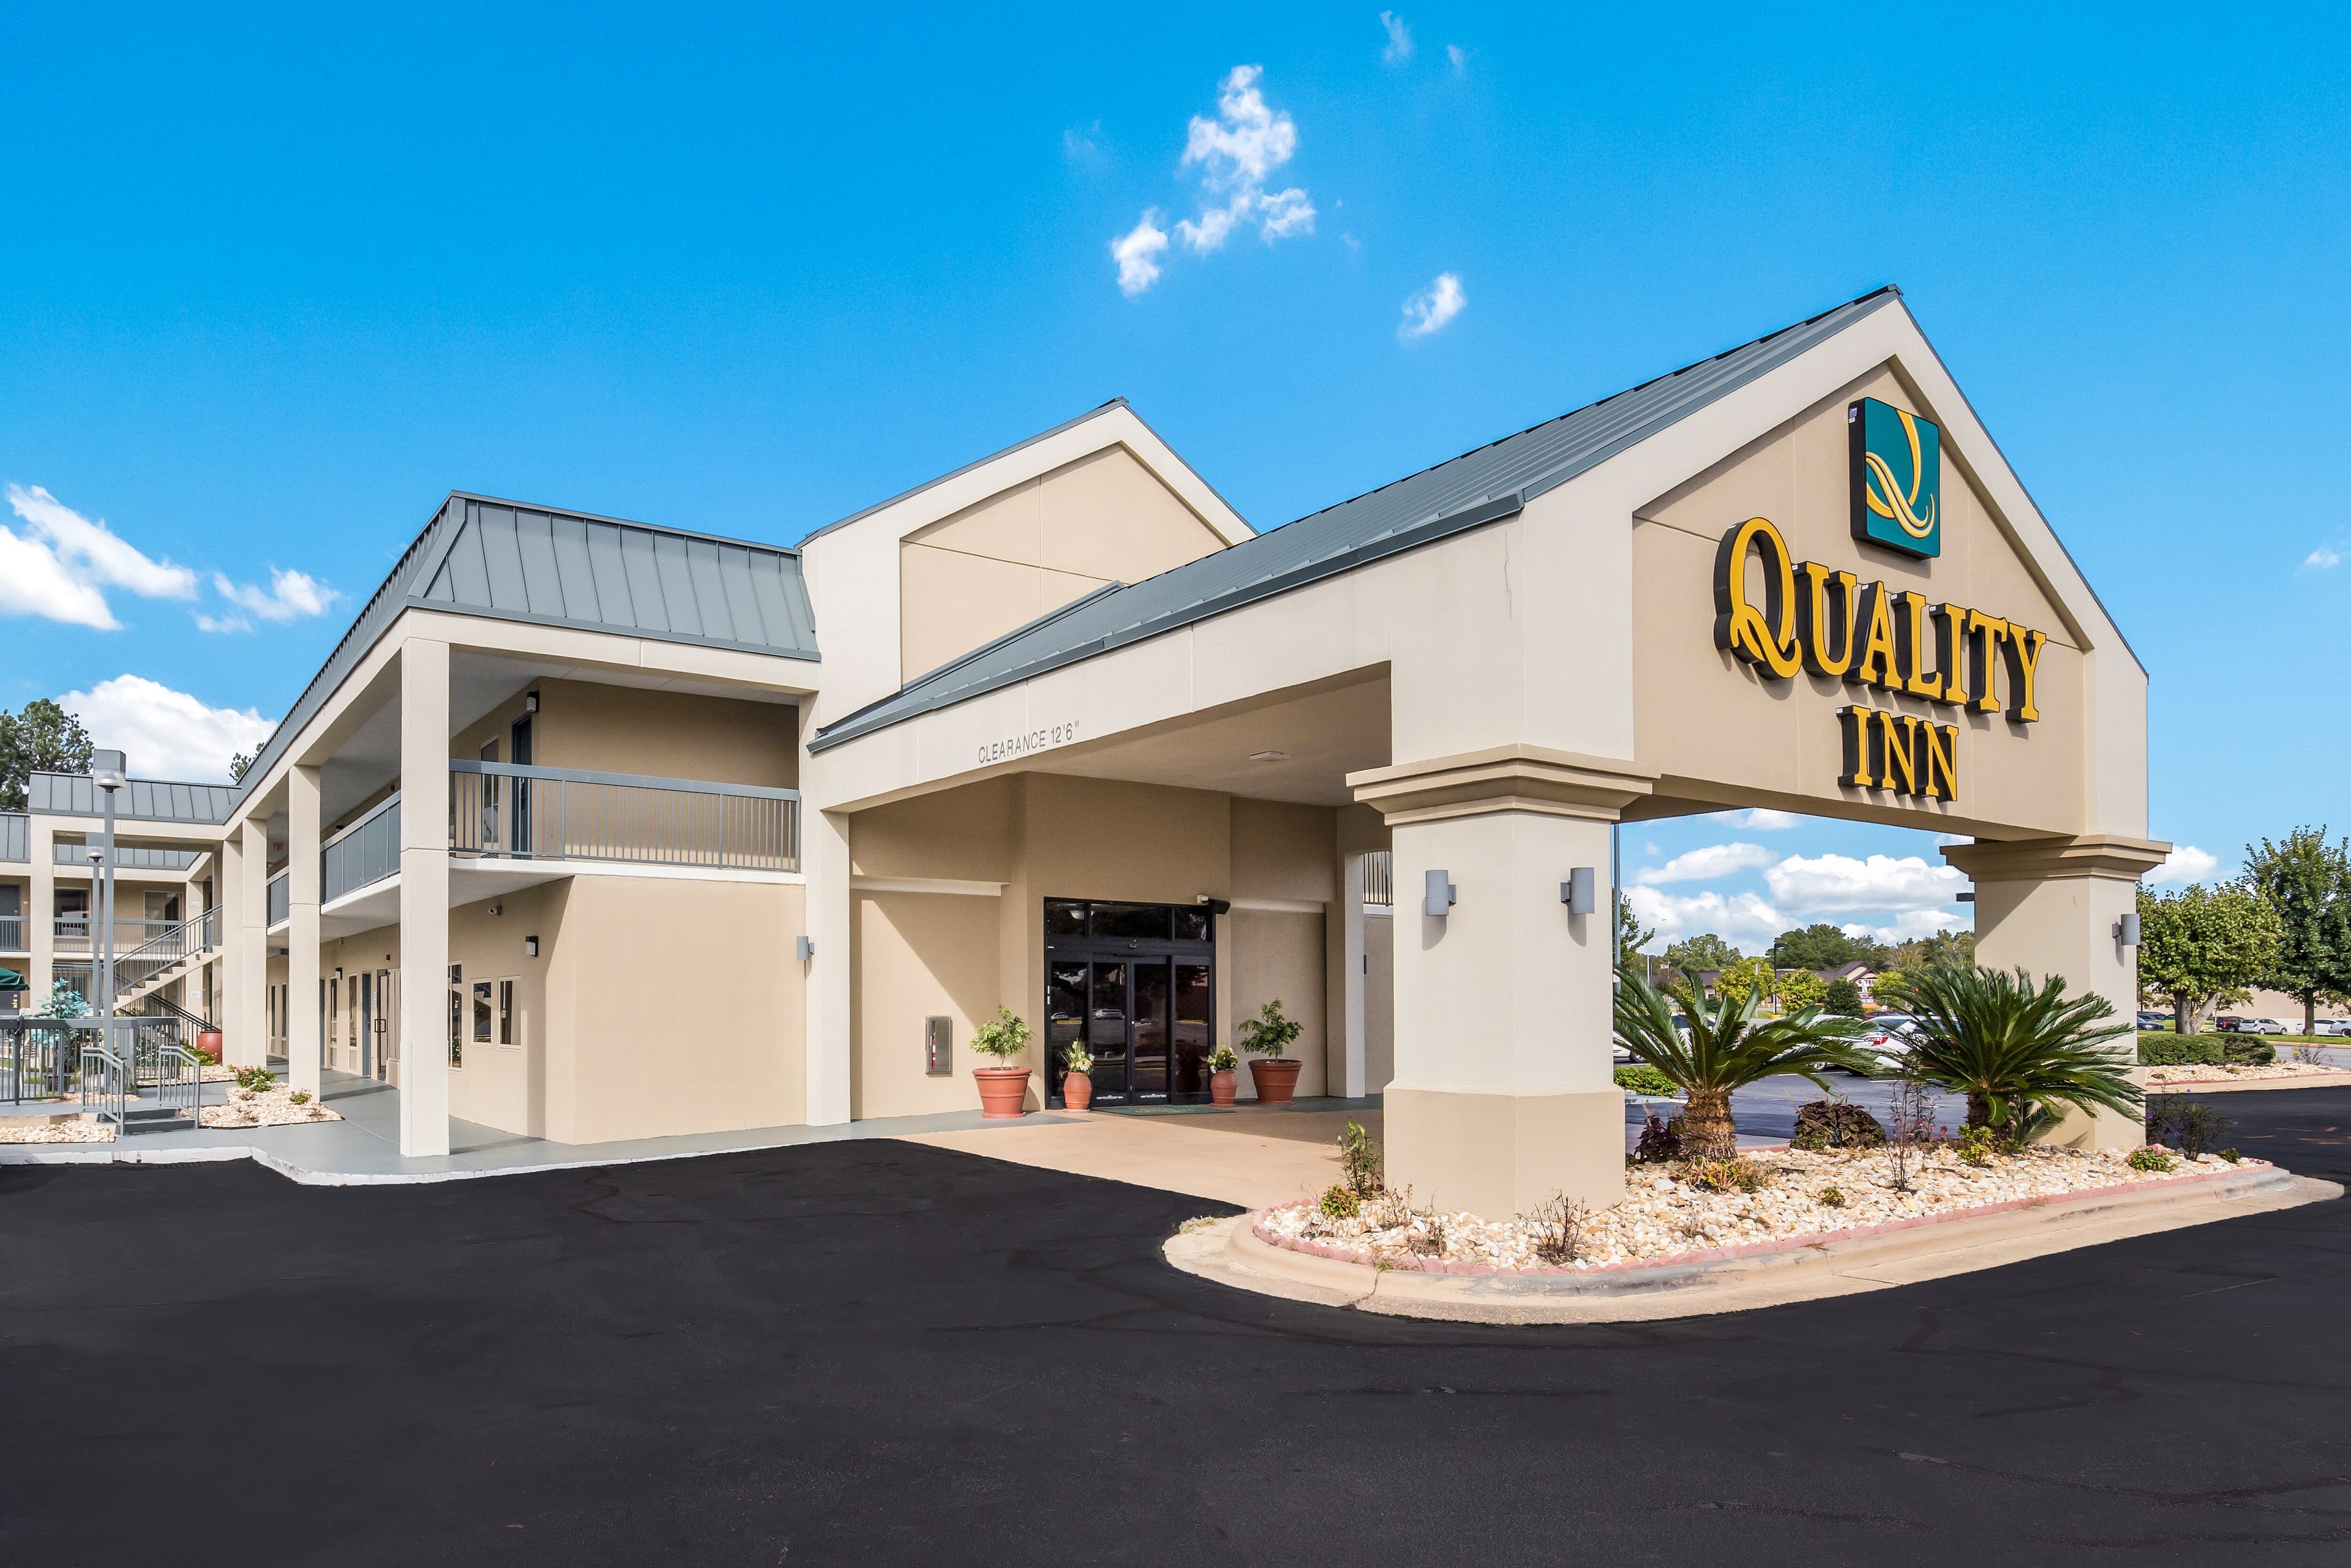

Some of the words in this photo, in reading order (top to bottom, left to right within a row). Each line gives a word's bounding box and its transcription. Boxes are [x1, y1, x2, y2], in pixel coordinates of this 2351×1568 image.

[1722, 517, 2047, 724] QUALITY
[978, 730, 1046, 763] CLEARANCE
[1844, 705, 1959, 802] INN
